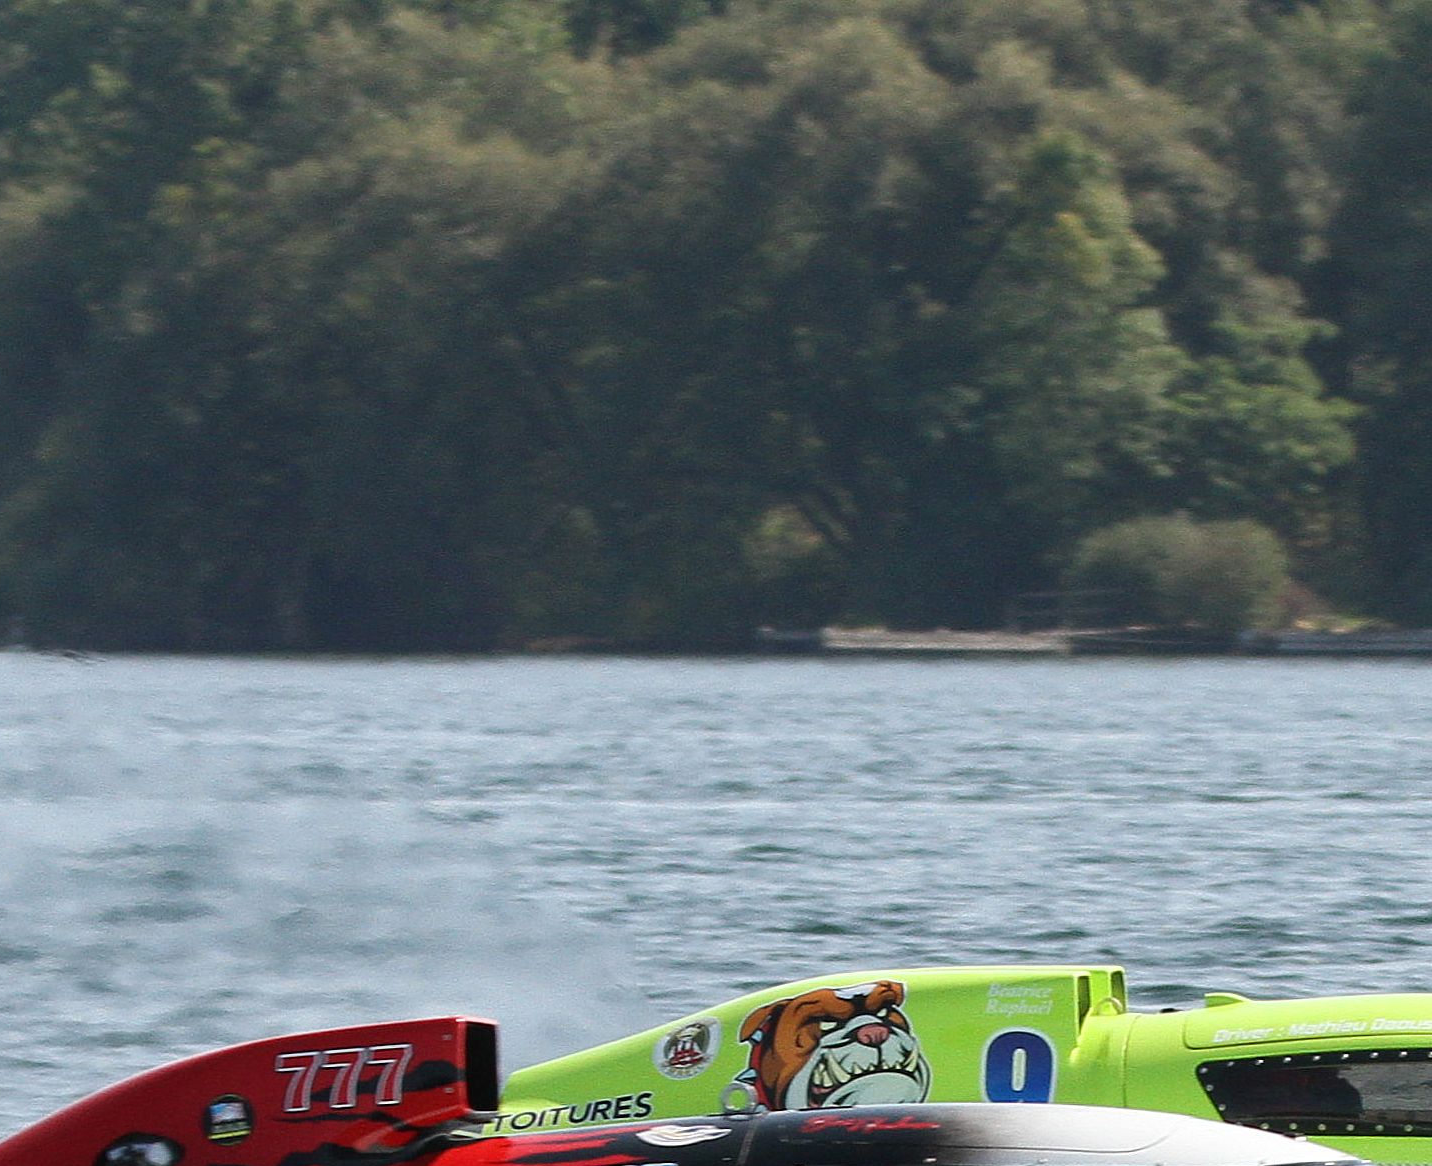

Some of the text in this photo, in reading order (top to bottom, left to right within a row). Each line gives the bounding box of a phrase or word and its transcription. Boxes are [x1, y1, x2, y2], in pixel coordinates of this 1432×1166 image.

[1212, 1028, 1272, 1043] Driver
[1288, 1020, 1366, 1036] Mathieu
[274, 1043, 413, 1112] 777
[495, 1092, 652, 1132] TOITURES
